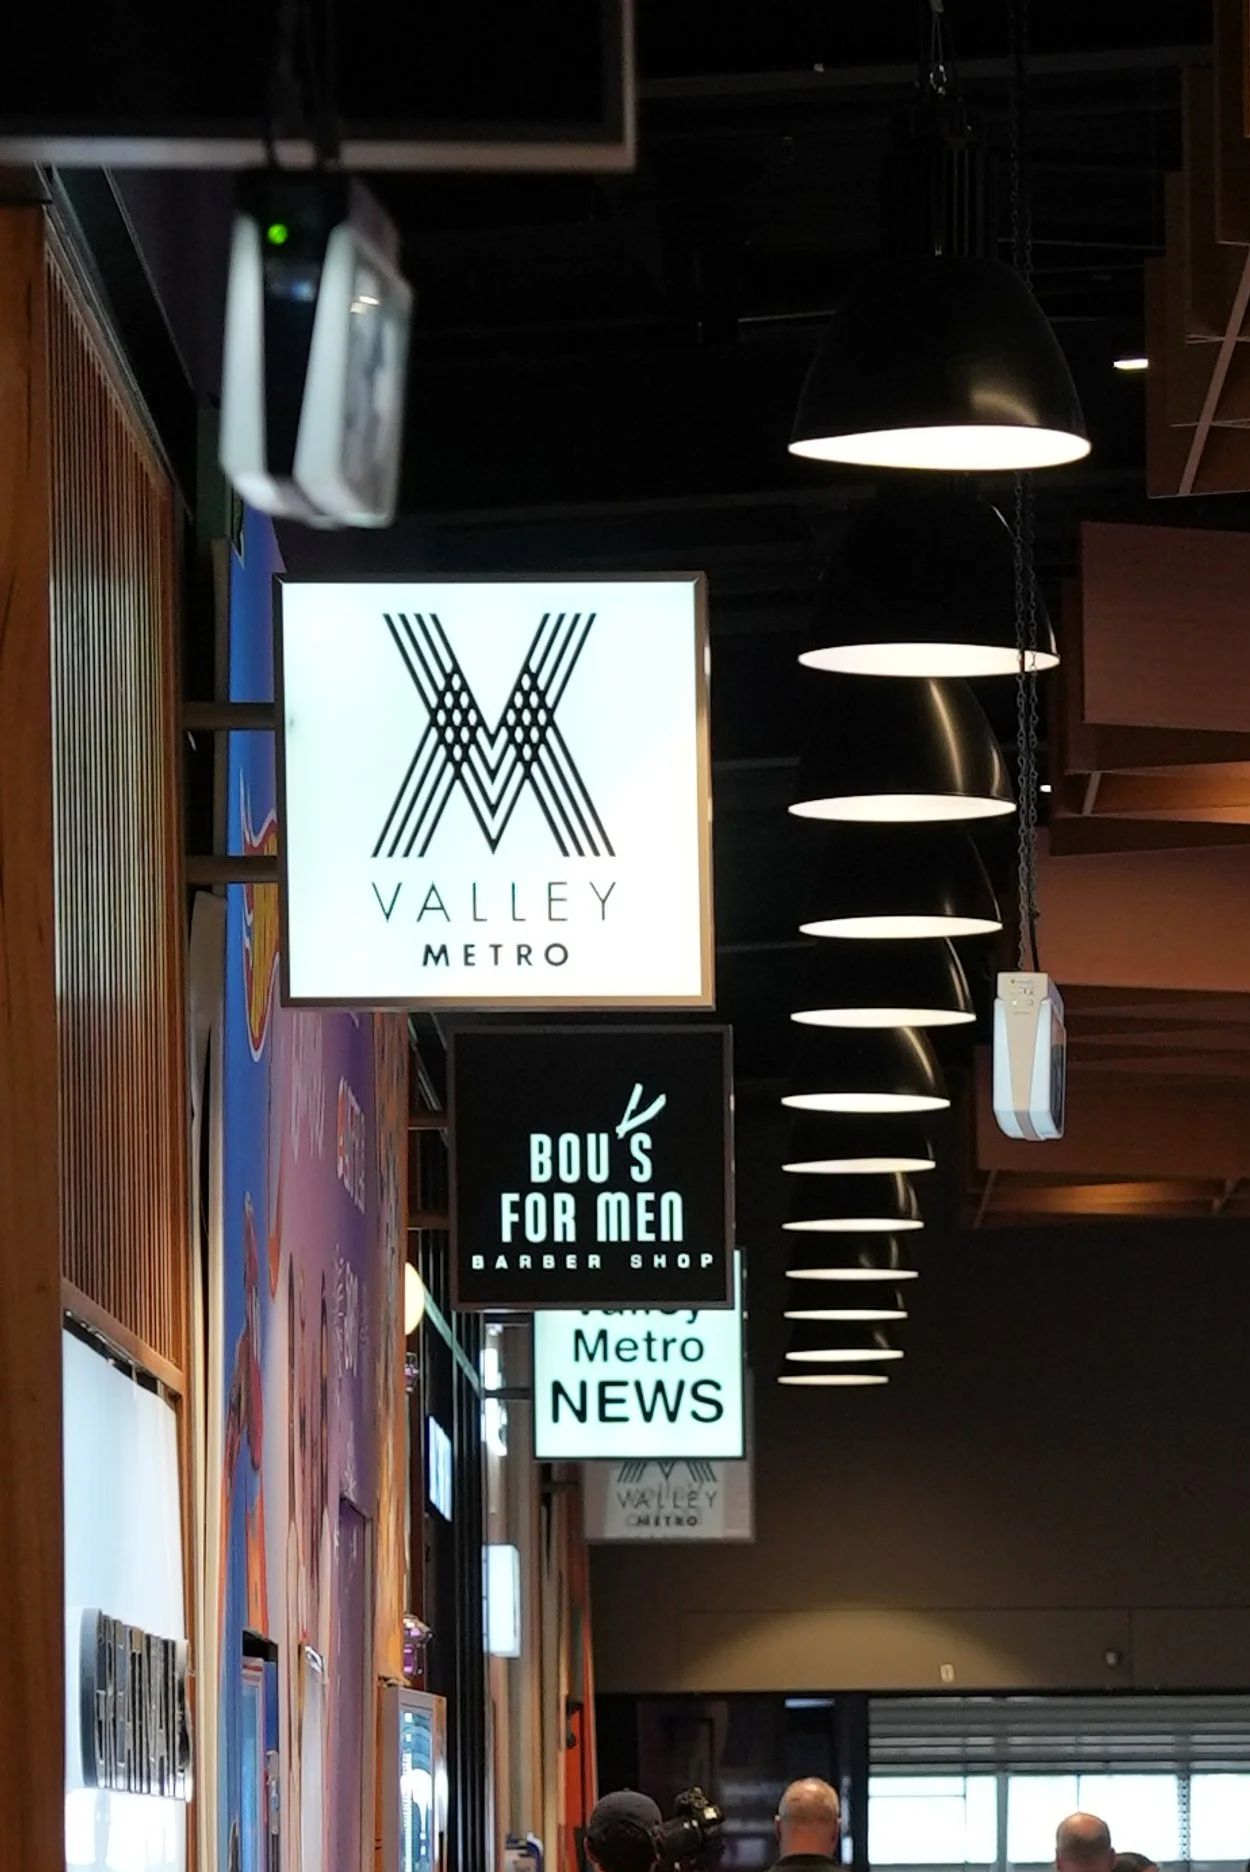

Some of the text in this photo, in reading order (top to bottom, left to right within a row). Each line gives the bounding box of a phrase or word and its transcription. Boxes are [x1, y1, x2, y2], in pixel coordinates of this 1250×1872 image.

[372, 881, 618, 923] VALLEY
[423, 943, 569, 968] METRO
[501, 1192, 684, 1243] FOR MEN
[472, 1254, 714, 1270] BARBER SHOP
[574, 1328, 705, 1363] Metro
[551, 1379, 724, 1424] NEWS
